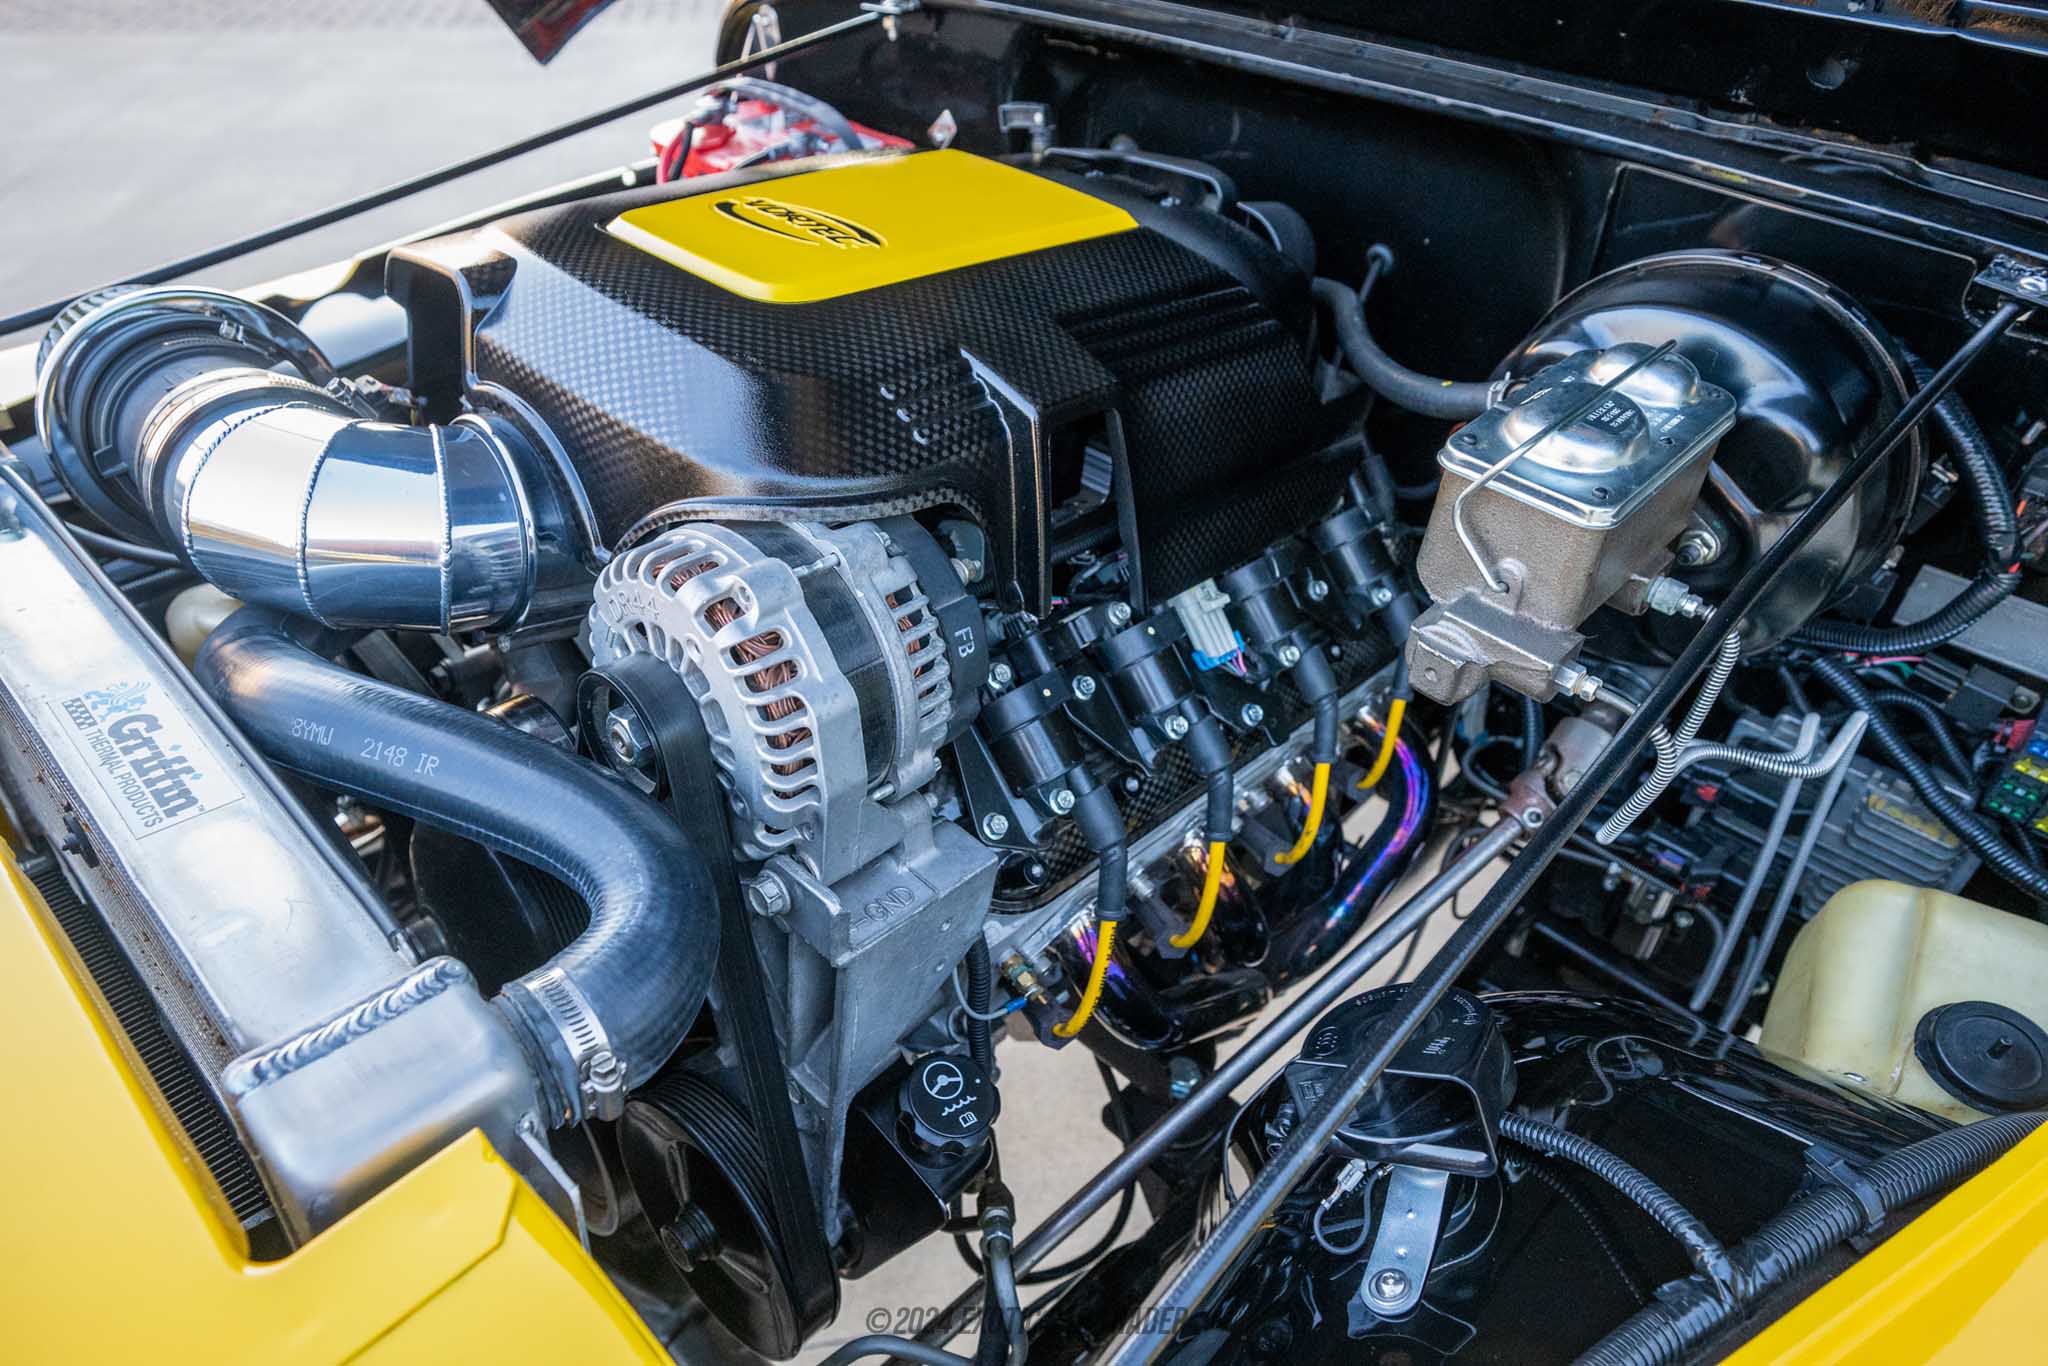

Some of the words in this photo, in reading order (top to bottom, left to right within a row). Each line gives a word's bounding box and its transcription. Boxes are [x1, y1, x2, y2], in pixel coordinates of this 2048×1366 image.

[954, 626, 975, 658] FB
[86, 727, 127, 775] THERMAL
[113, 767, 164, 828] PRODUCTS
[107, 713, 203, 818] Griffin
[360, 737, 408, 768] 2148
